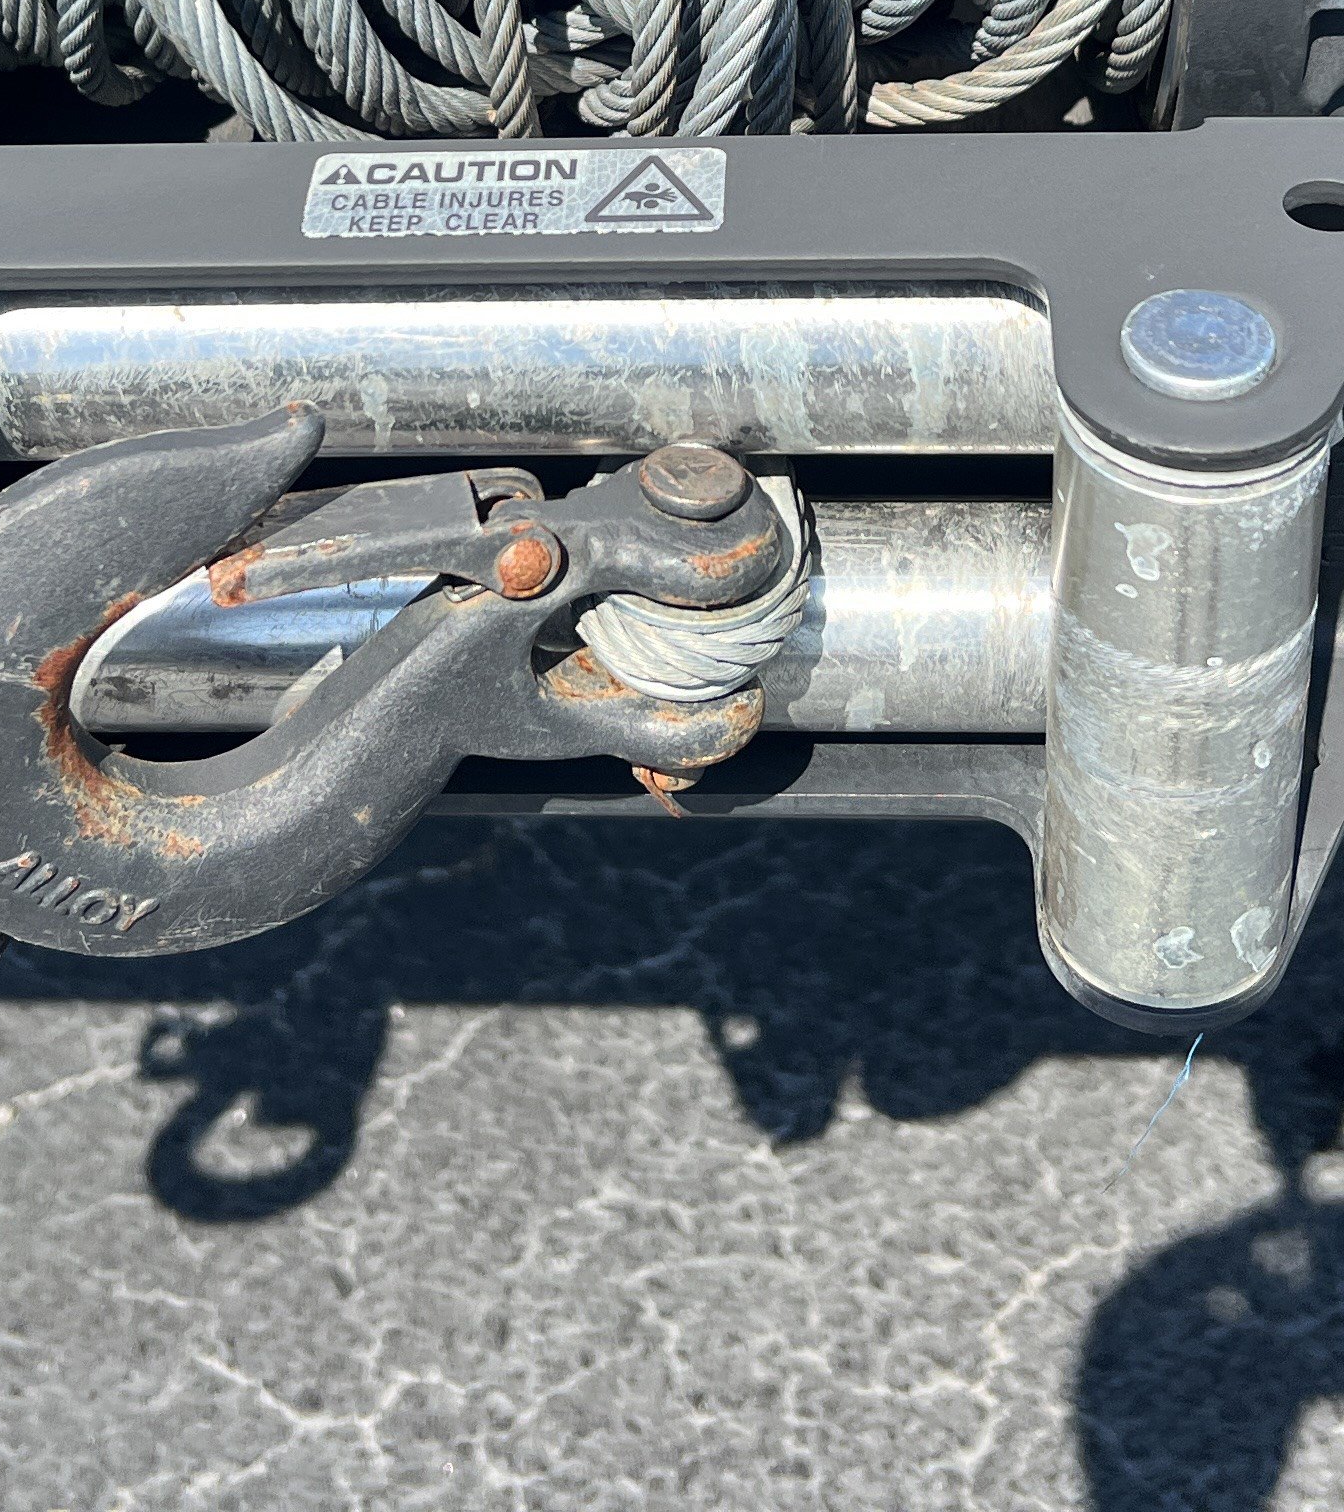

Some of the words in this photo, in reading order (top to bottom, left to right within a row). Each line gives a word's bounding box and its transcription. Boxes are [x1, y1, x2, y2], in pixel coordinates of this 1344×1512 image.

[365, 158, 579, 184] CAUTION
[330, 192, 428, 211] CABLE
[438, 190, 565, 209] INJURES
[348, 215, 423, 233] KEEP
[444, 213, 540, 232] CLEAR
